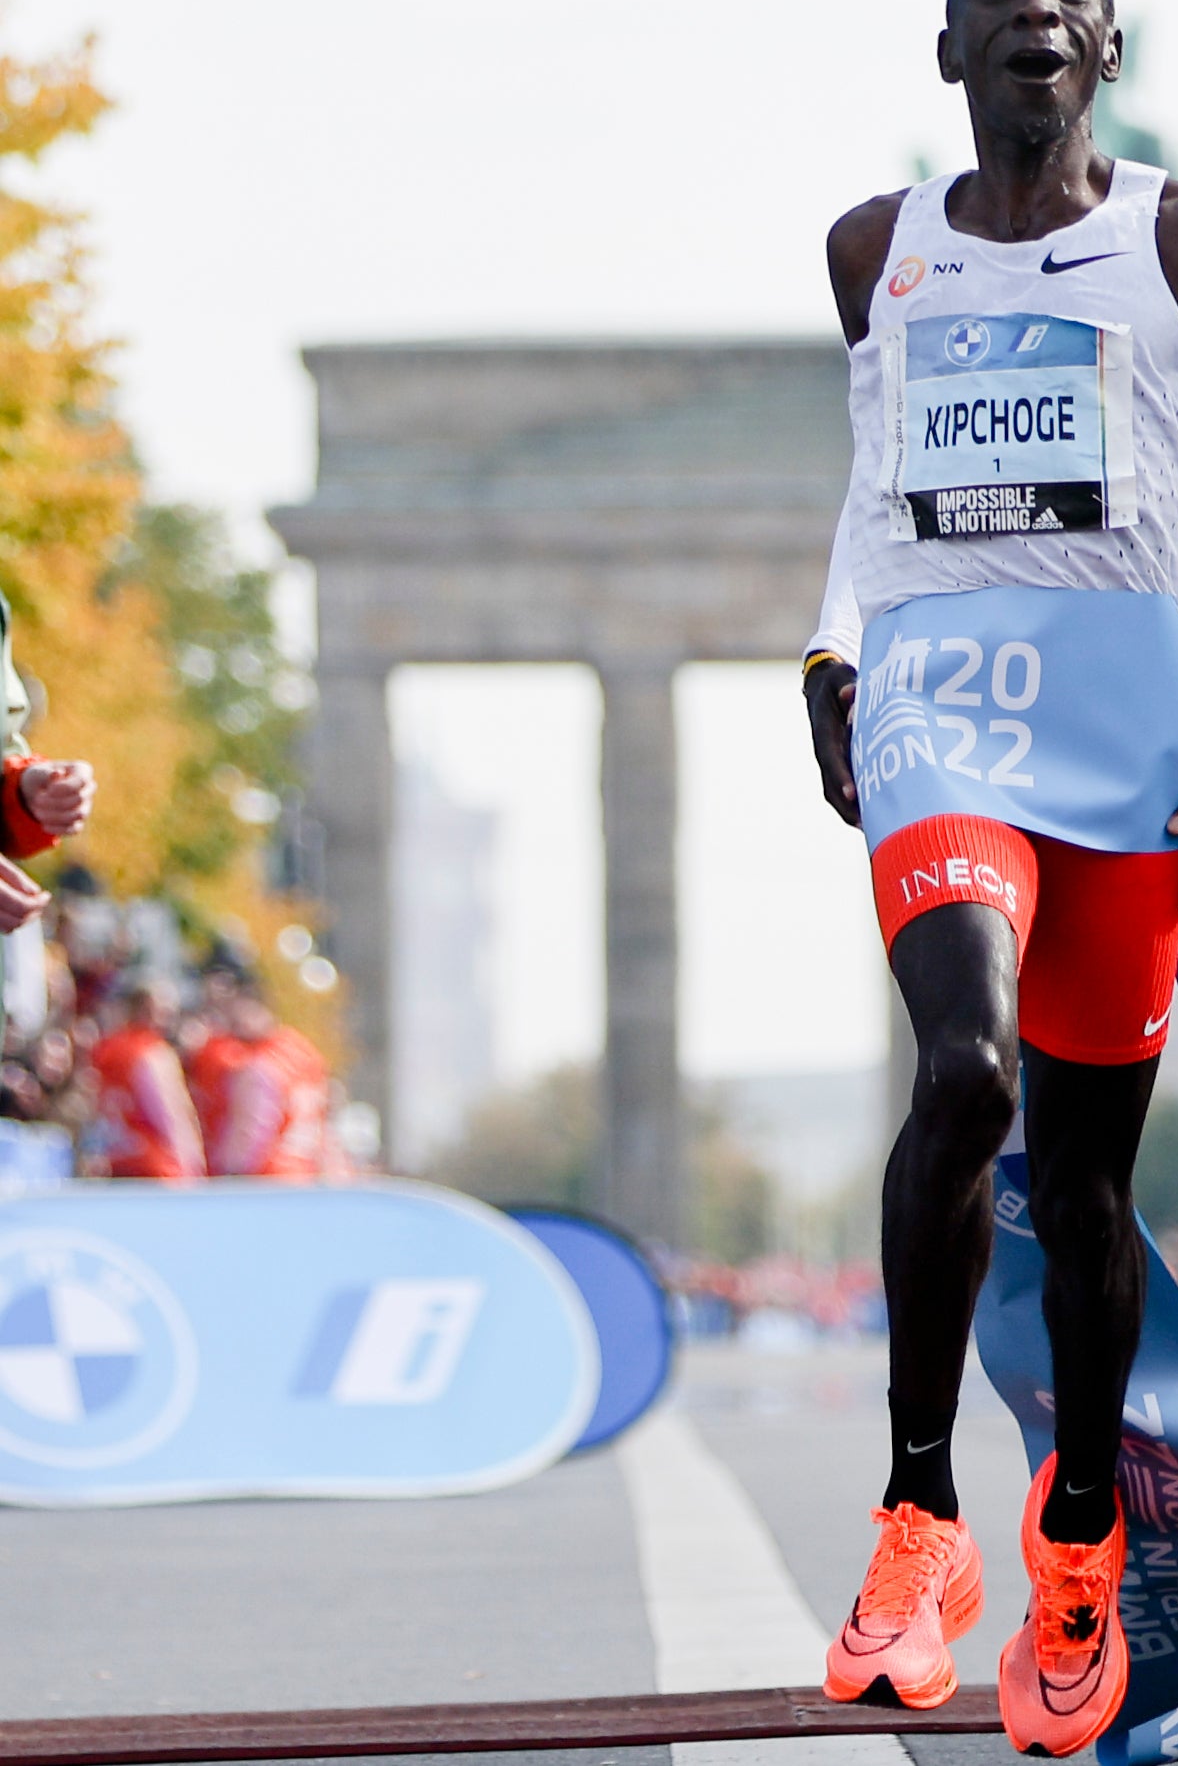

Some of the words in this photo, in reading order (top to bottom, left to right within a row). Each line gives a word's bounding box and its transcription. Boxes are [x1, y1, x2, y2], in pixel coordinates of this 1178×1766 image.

[933, 262, 964, 275] NN
[924, 396, 1076, 450] KIPCHOGE
[992, 458, 1002, 474] 1
[936, 486, 1036, 512] IMPOSSIBLE
[937, 513, 953, 534] IS
[955, 509, 1031, 532] NOTHING
[1031, 520, 1064, 530] adidas
[934, 637, 1042, 711] 20
[936, 715, 1035, 788] 22
[900, 857, 1018, 913] INEOS
